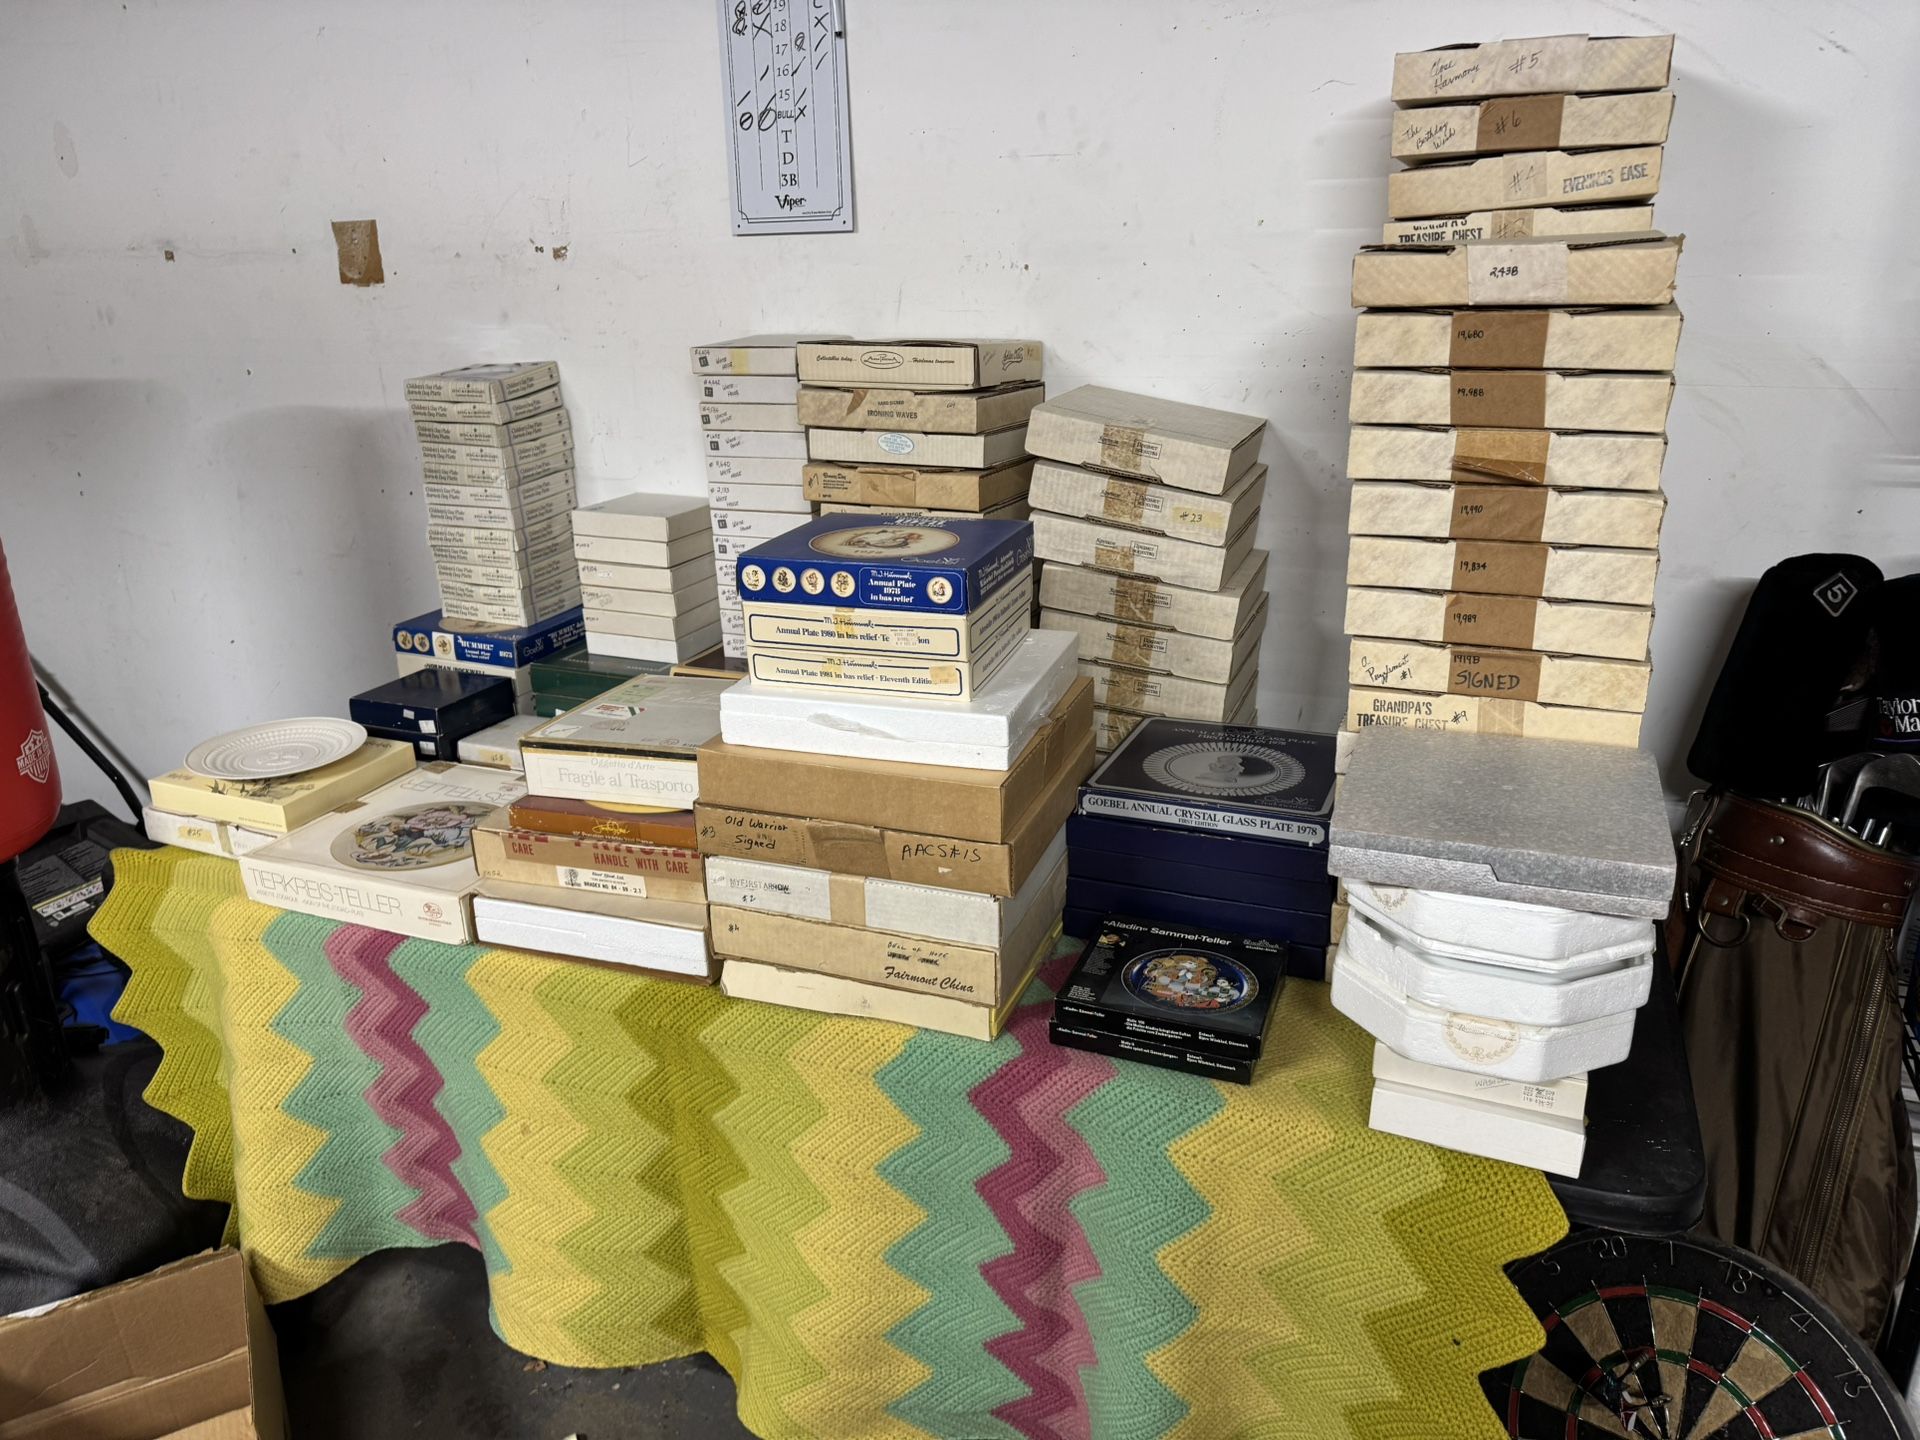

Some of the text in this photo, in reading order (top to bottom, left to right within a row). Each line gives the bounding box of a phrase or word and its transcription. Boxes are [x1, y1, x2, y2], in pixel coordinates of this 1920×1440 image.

[775, 19, 787, 32] 18
[776, 44, 788, 55] 17
[777, 64, 790, 76] 16
[779, 89, 790, 101] 15
[777, 109, 794, 119] BULL
[781, 130, 792, 143] T
[783, 152, 794, 165] D
[1620, 163, 1648, 182] EASE
[781, 174, 797, 187] 3B
[775, 195, 807, 211] Viper
[896, 411, 918, 419] WAVES
[868, 578, 917, 588] Annual Plate
[870, 593, 914, 603] in bas relief
[883, 587, 901, 595] 1978
[775, 626, 801, 636] Annual
[802, 628, 819, 637] Plate
[820, 630, 836, 639] 1980
[837, 631, 845, 639] in
[846, 631, 858, 640] bas
[775, 667, 800, 676] Annual
[801, 668, 819, 677] Plate
[819, 670, 833, 678] 1981
[844, 672, 855, 680] bas
[856, 672, 874, 681] relief
[879, 674, 910, 684] Eleventh
[912, 677, 934, 686] Editio
[1455, 670, 1520, 690] SIGNED
[1373, 699, 1432, 715] GRANDPA'S
[1895, 716, 1920, 733] Ma
[18, 752, 37, 768] MADE
[591, 757, 656, 770] Oggetto d'Arte
[558, 767, 694, 794] Fragile al Trasporto
[725, 815, 788, 831] Old Warrior
[1088, 796, 1318, 836] GOEBEL ANNUAL CRYSTAL GLASS PLATE 1978
[1178, 817, 1219, 829] FIRST EDITION
[511, 842, 534, 856] CARE
[735, 834, 776, 851] Signed
[593, 852, 689, 874] HANDLE WITH CARE
[1150, 927, 1232, 947] Sammel-Teller
[884, 966, 975, 993] Fairmont China
